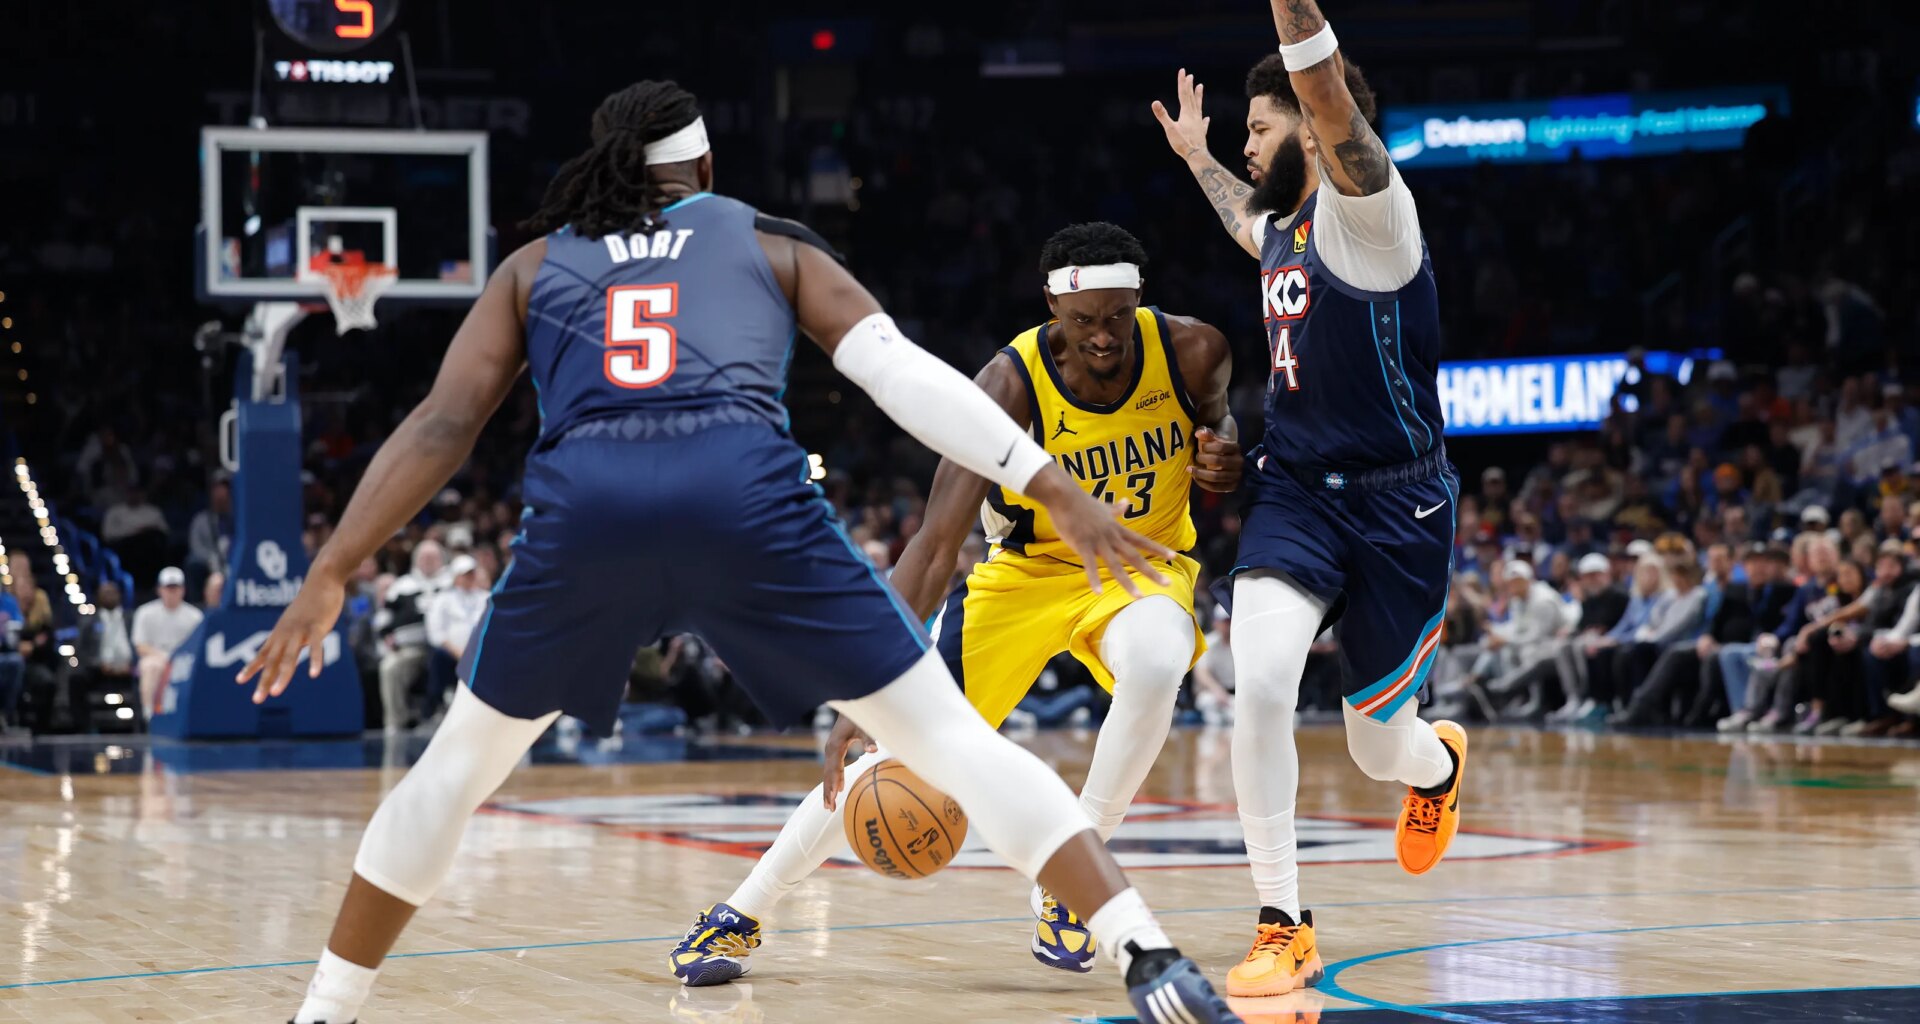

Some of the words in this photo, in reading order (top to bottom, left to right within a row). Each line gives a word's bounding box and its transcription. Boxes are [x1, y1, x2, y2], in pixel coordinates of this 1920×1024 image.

[335, 0, 374, 38] 5
[307, 60, 394, 83] TISSOT
[604, 229, 694, 263] DORT
[1261, 265, 1310, 322] KC
[604, 281, 679, 390] 5
[1268, 324, 1299, 393] 4
[1135, 394, 1158, 411] LUCAS
[1159, 390, 1171, 401] OIL
[1051, 420, 1185, 481] NDIANA
